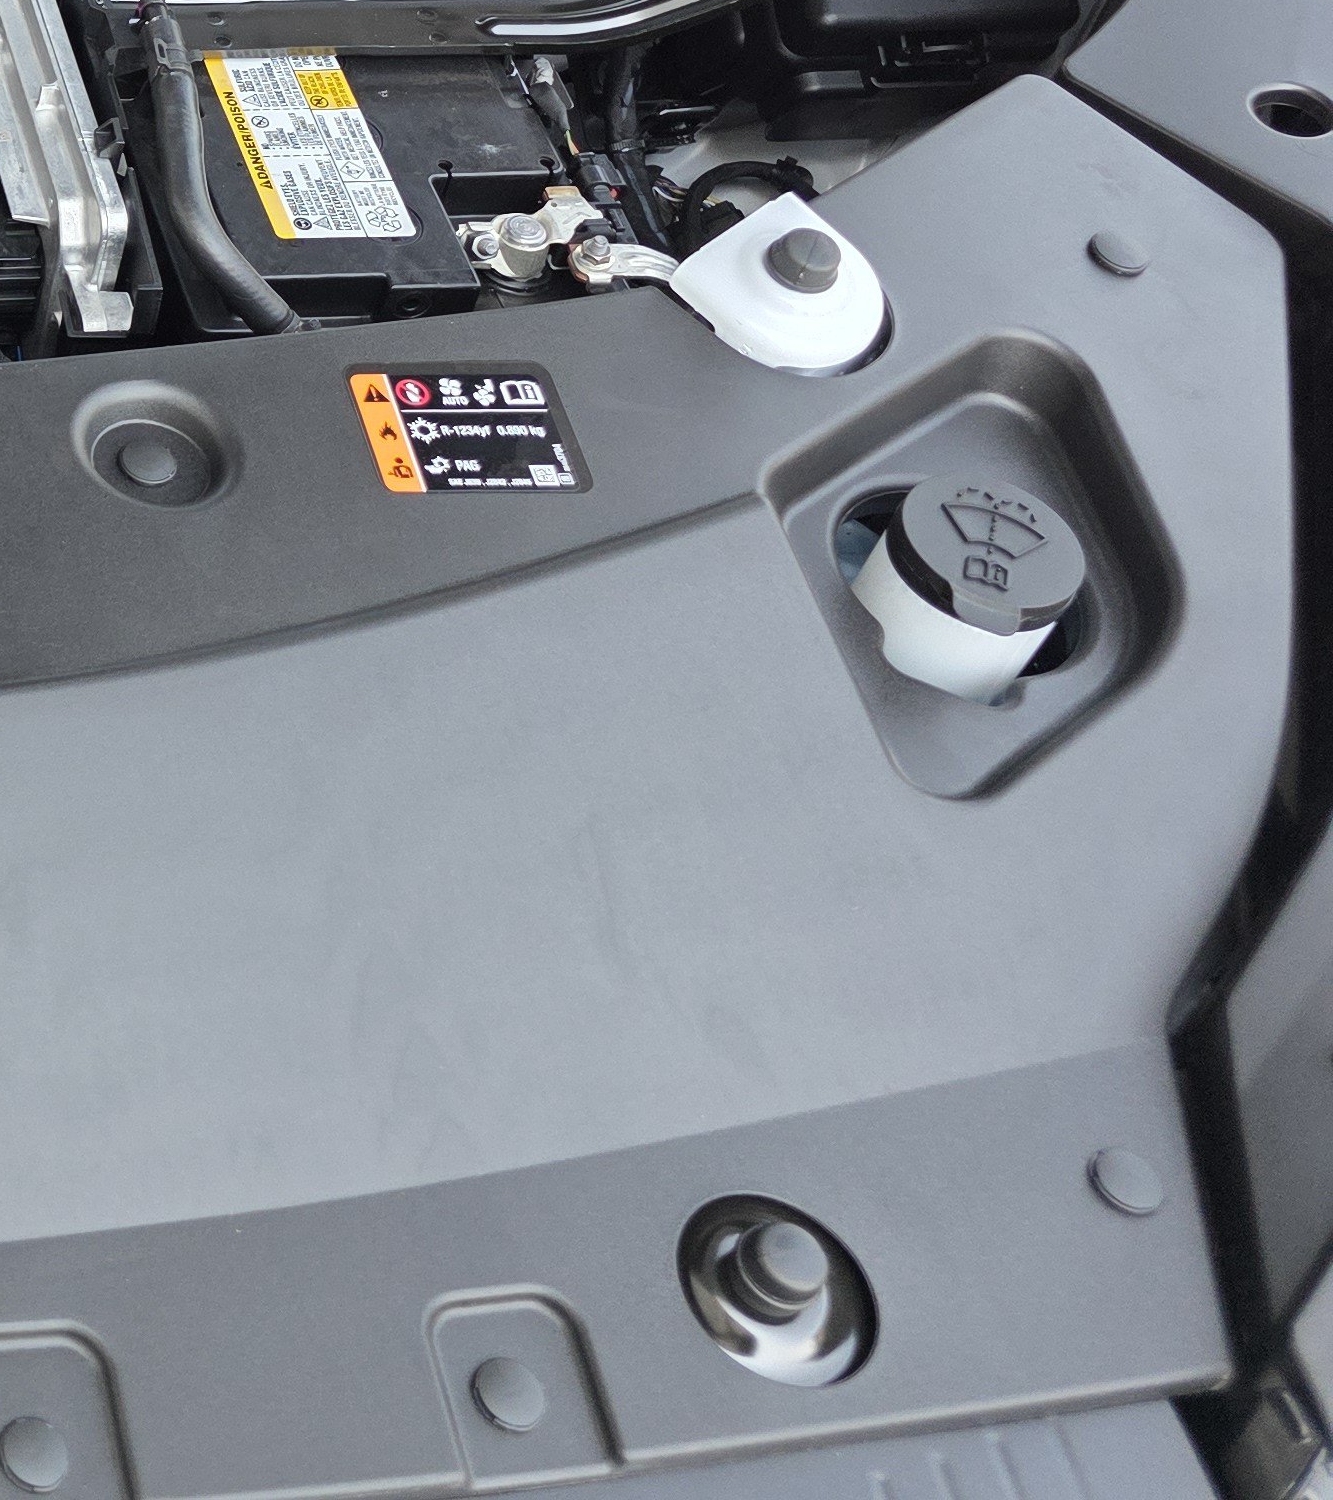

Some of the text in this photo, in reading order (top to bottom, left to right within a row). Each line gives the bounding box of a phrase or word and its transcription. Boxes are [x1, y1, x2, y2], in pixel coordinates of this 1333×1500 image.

[279, 57, 287, 66] GRA
[232, 70, 247, 92] SULFURIC
[263, 63, 280, 89] SULFURIQUE
[223, 92, 268, 179] DANGER/POISON
[283, 171, 309, 216] EXPLOSIVE GASES
[321, 194, 333, 203] LES
[324, 181, 343, 208] EXPLOSIFS
[310, 207, 318, 216] CAN
[338, 210, 347, 219] GAZ
[342, 222, 353, 230] LES
[442, 396, 469, 406] AUTO
[440, 425, 491, 438] R-1234yf
[529, 425, 547, 438] kg
[454, 459, 481, 472] PAG
